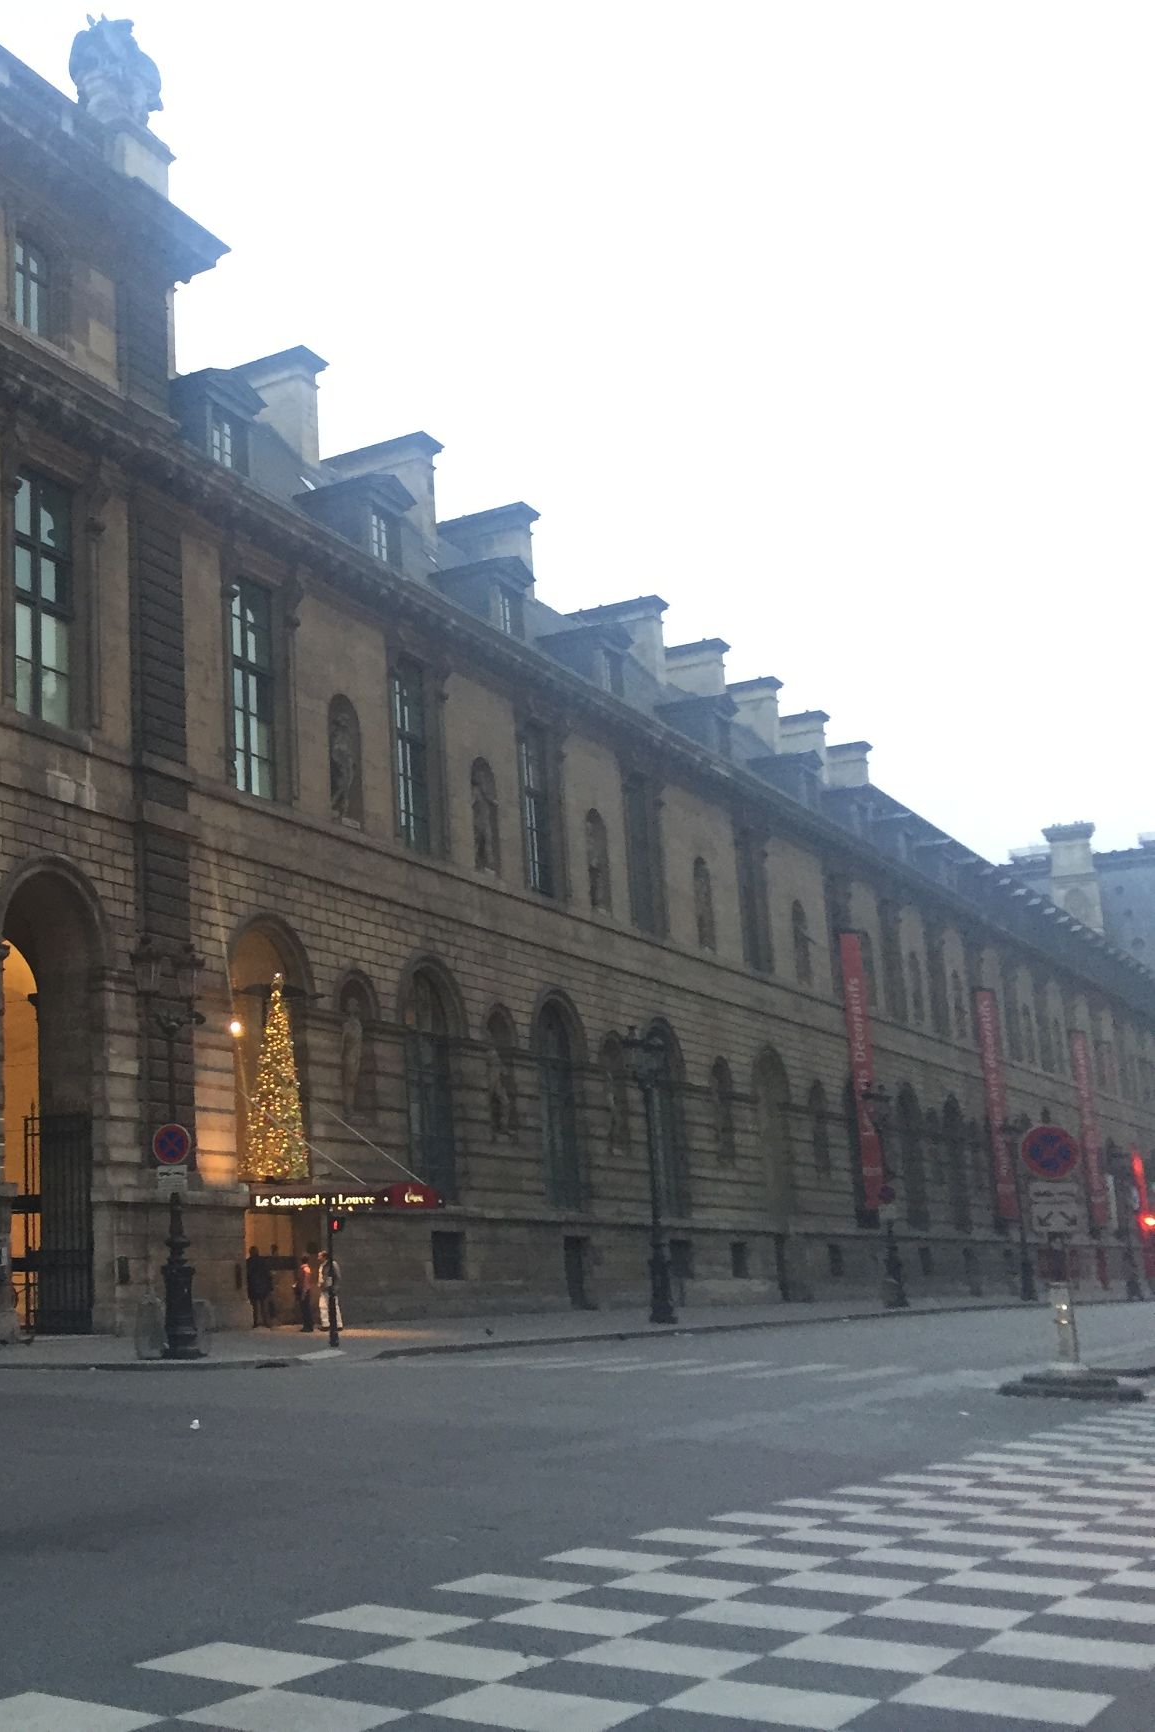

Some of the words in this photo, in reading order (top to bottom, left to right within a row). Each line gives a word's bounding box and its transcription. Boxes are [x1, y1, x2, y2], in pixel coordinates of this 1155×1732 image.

[847, 977, 867, 1062] Décoratifs
[255, 1195, 270, 1207] Le
[270, 1194, 320, 1206] Carrousel
[338, 1193, 376, 1205] Louvre
